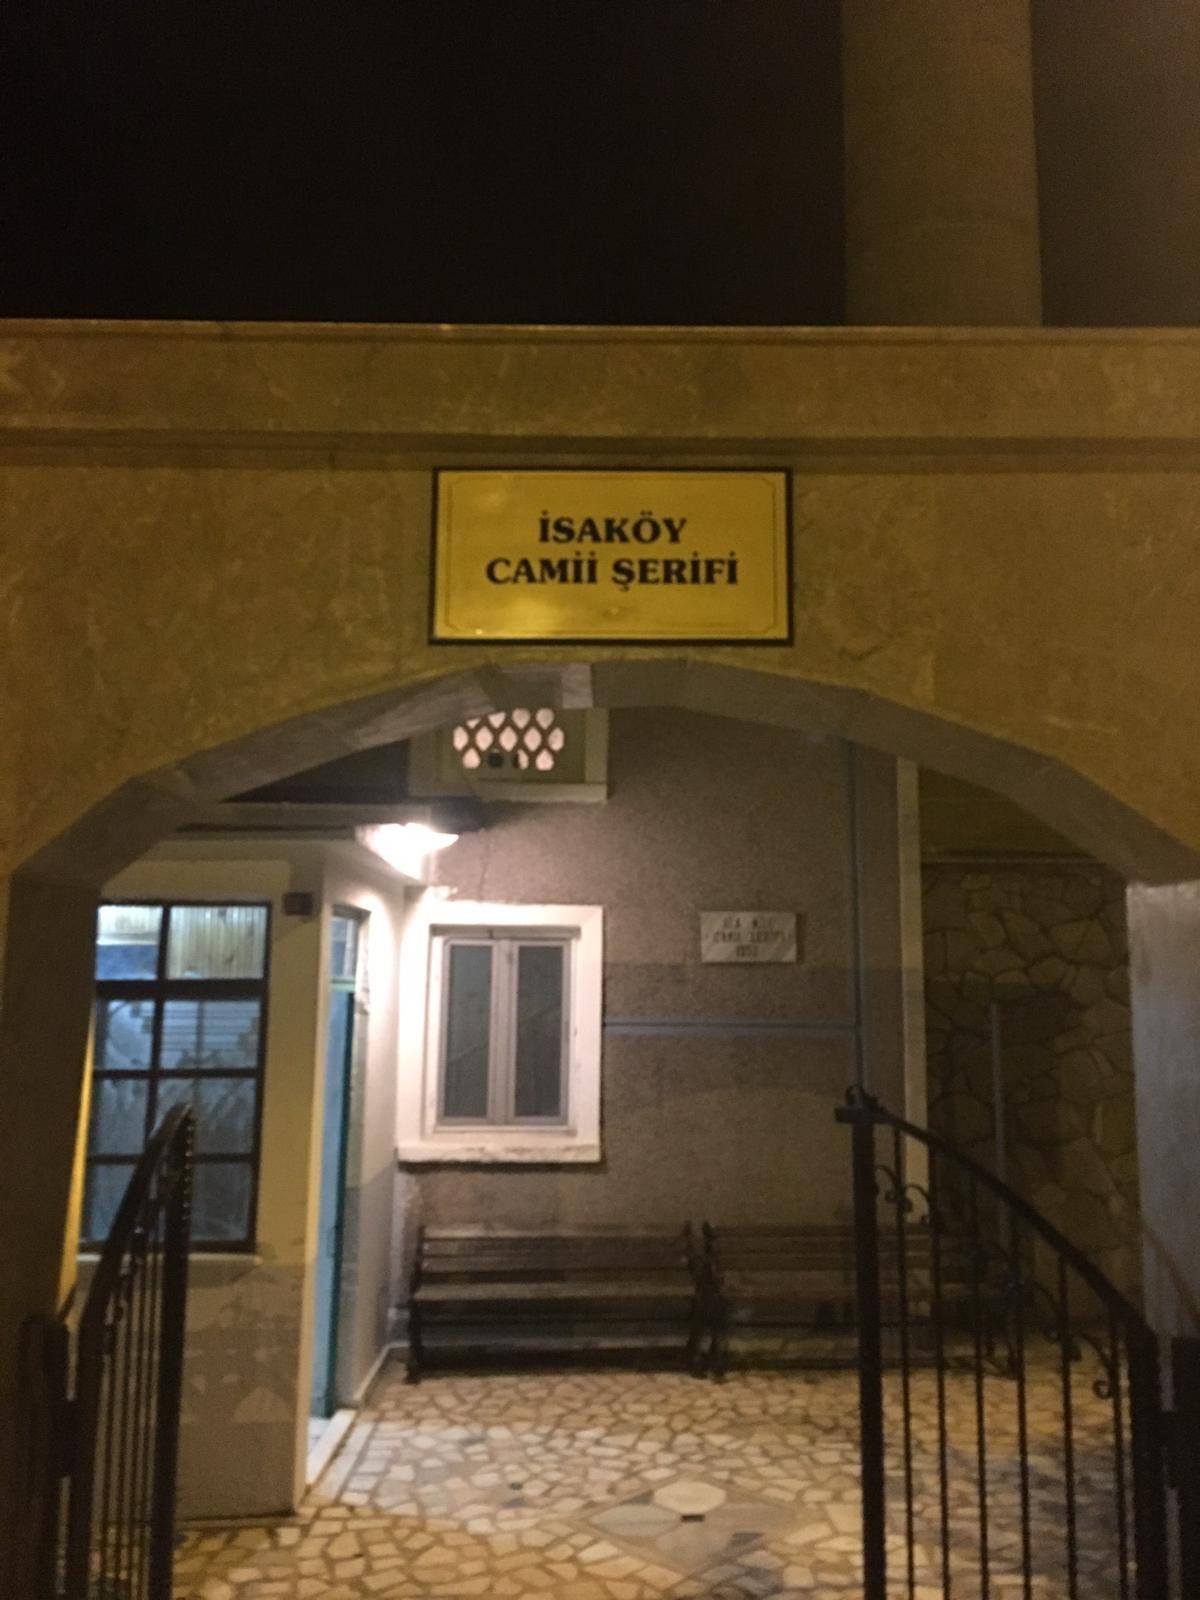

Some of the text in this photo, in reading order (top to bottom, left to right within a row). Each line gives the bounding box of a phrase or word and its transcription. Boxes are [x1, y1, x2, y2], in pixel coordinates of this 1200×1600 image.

[539, 510, 687, 543] İSAKÖY
[486, 551, 739, 592] CAMİİ ŞERİFİ
